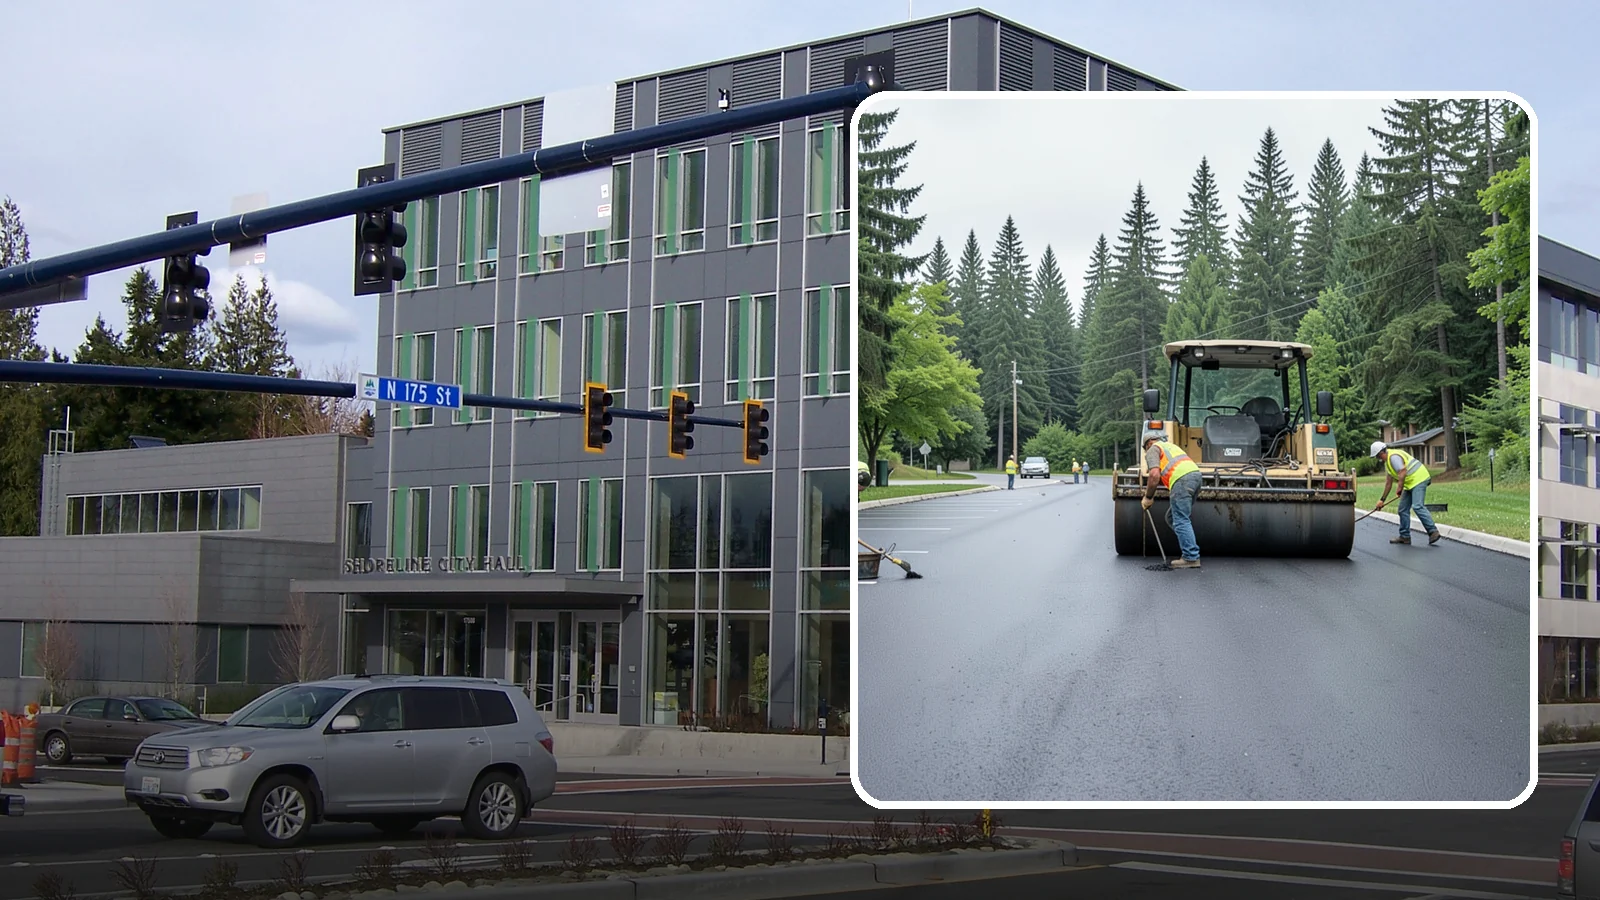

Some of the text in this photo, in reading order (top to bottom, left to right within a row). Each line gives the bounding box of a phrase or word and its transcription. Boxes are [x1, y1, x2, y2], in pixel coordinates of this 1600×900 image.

[387, 381, 451, 405] N 175 St
[343, 555, 526, 574] SHORELINE CITY HALL
